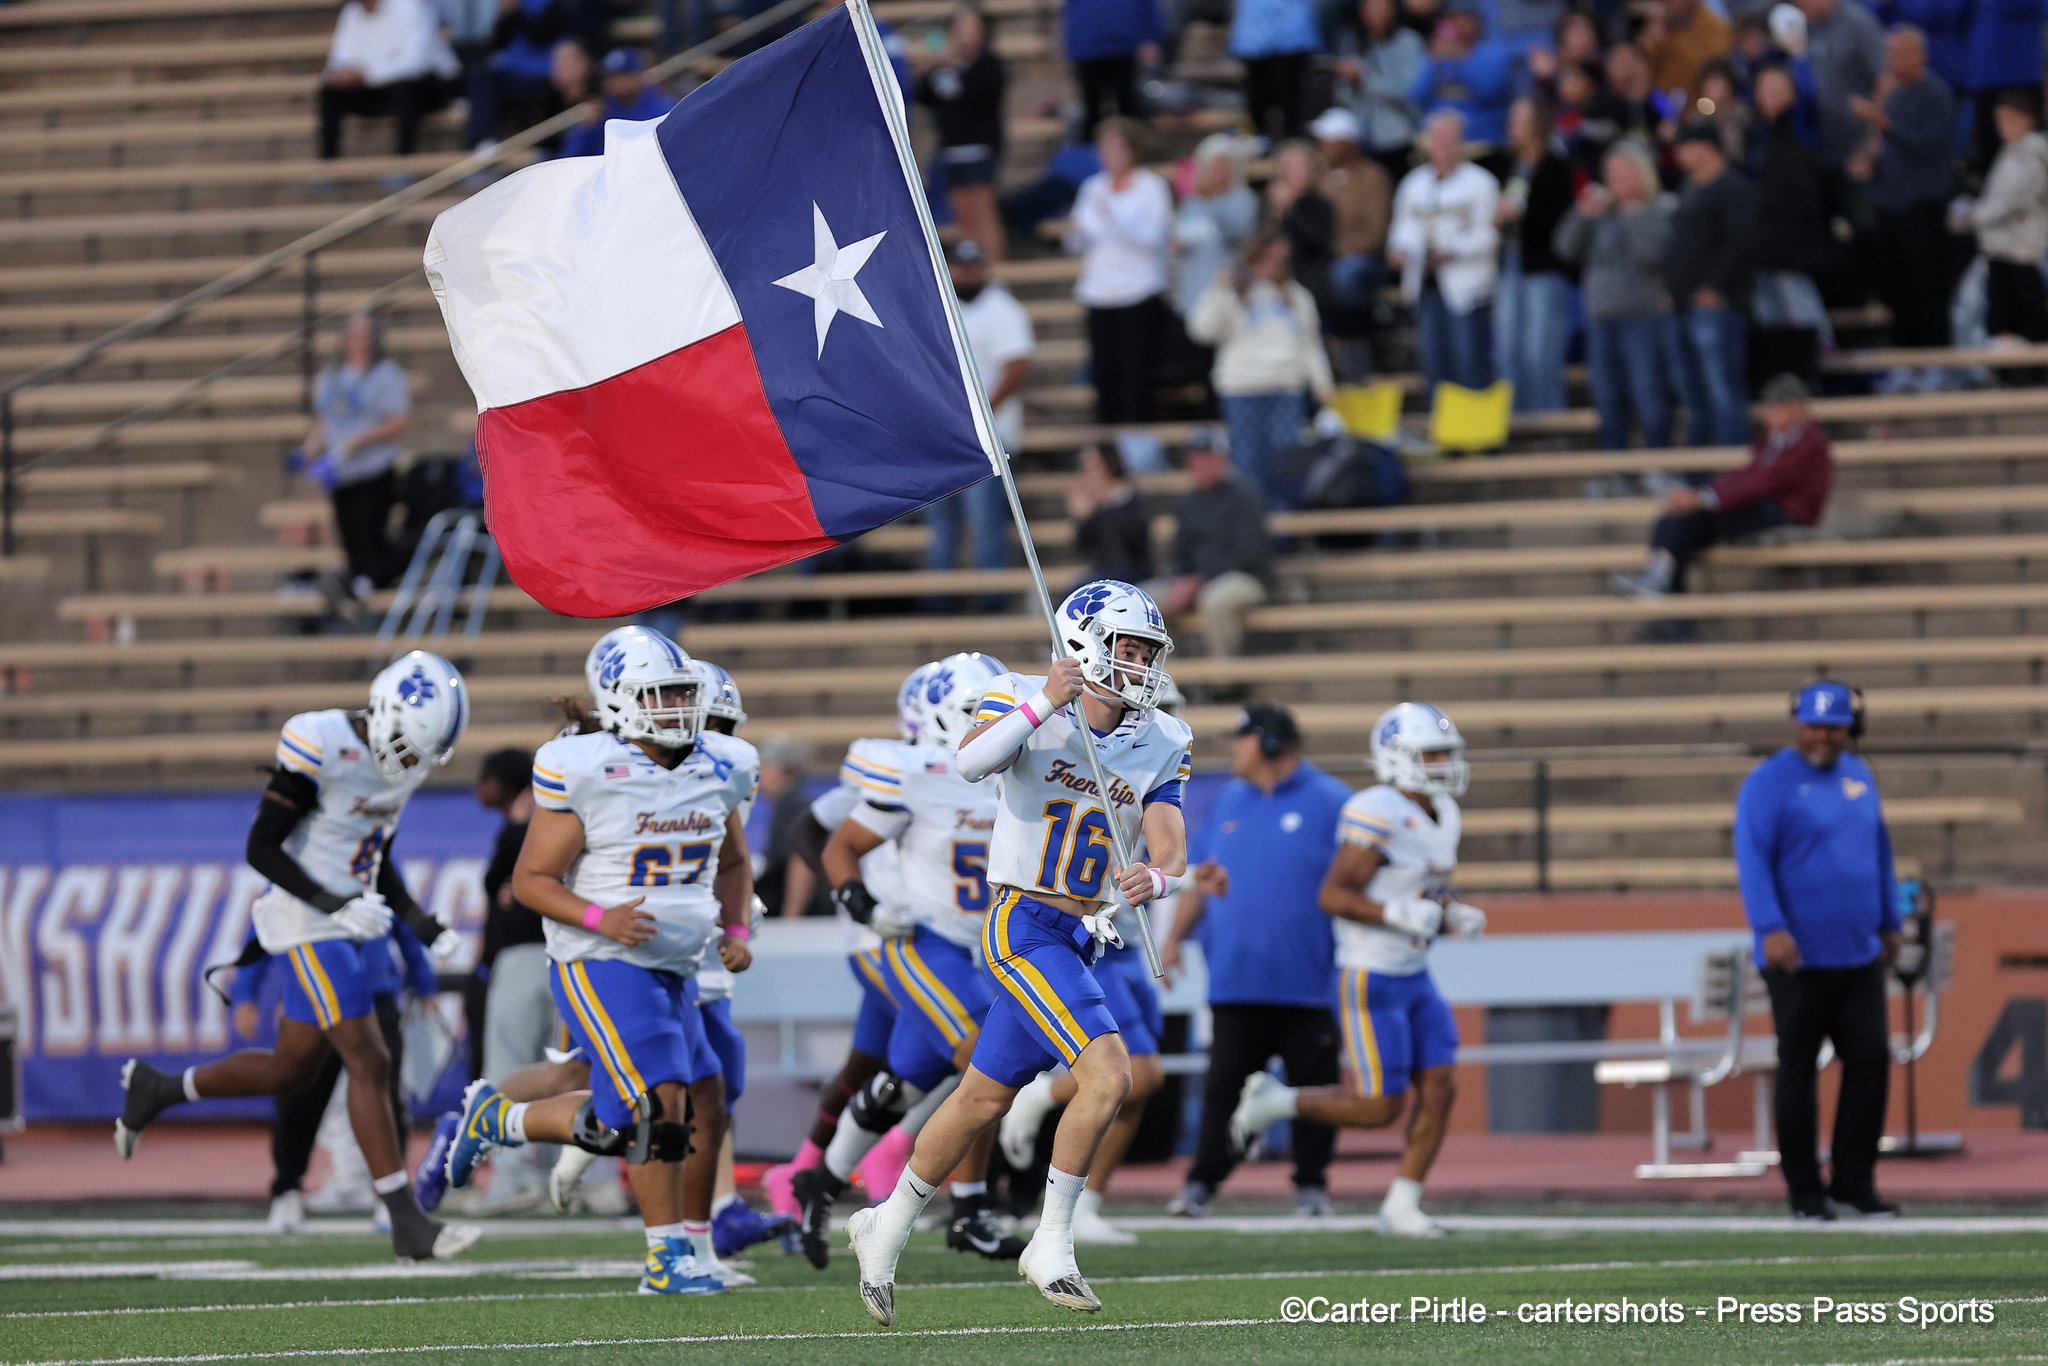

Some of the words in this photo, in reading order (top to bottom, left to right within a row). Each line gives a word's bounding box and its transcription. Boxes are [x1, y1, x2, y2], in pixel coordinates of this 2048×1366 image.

[1045, 758, 1135, 809] Frenhip
[634, 810, 713, 836] Frenship
[627, 839, 713, 887] 67
[1035, 798, 1121, 901] 16
[1966, 993, 2048, 1132] 4
